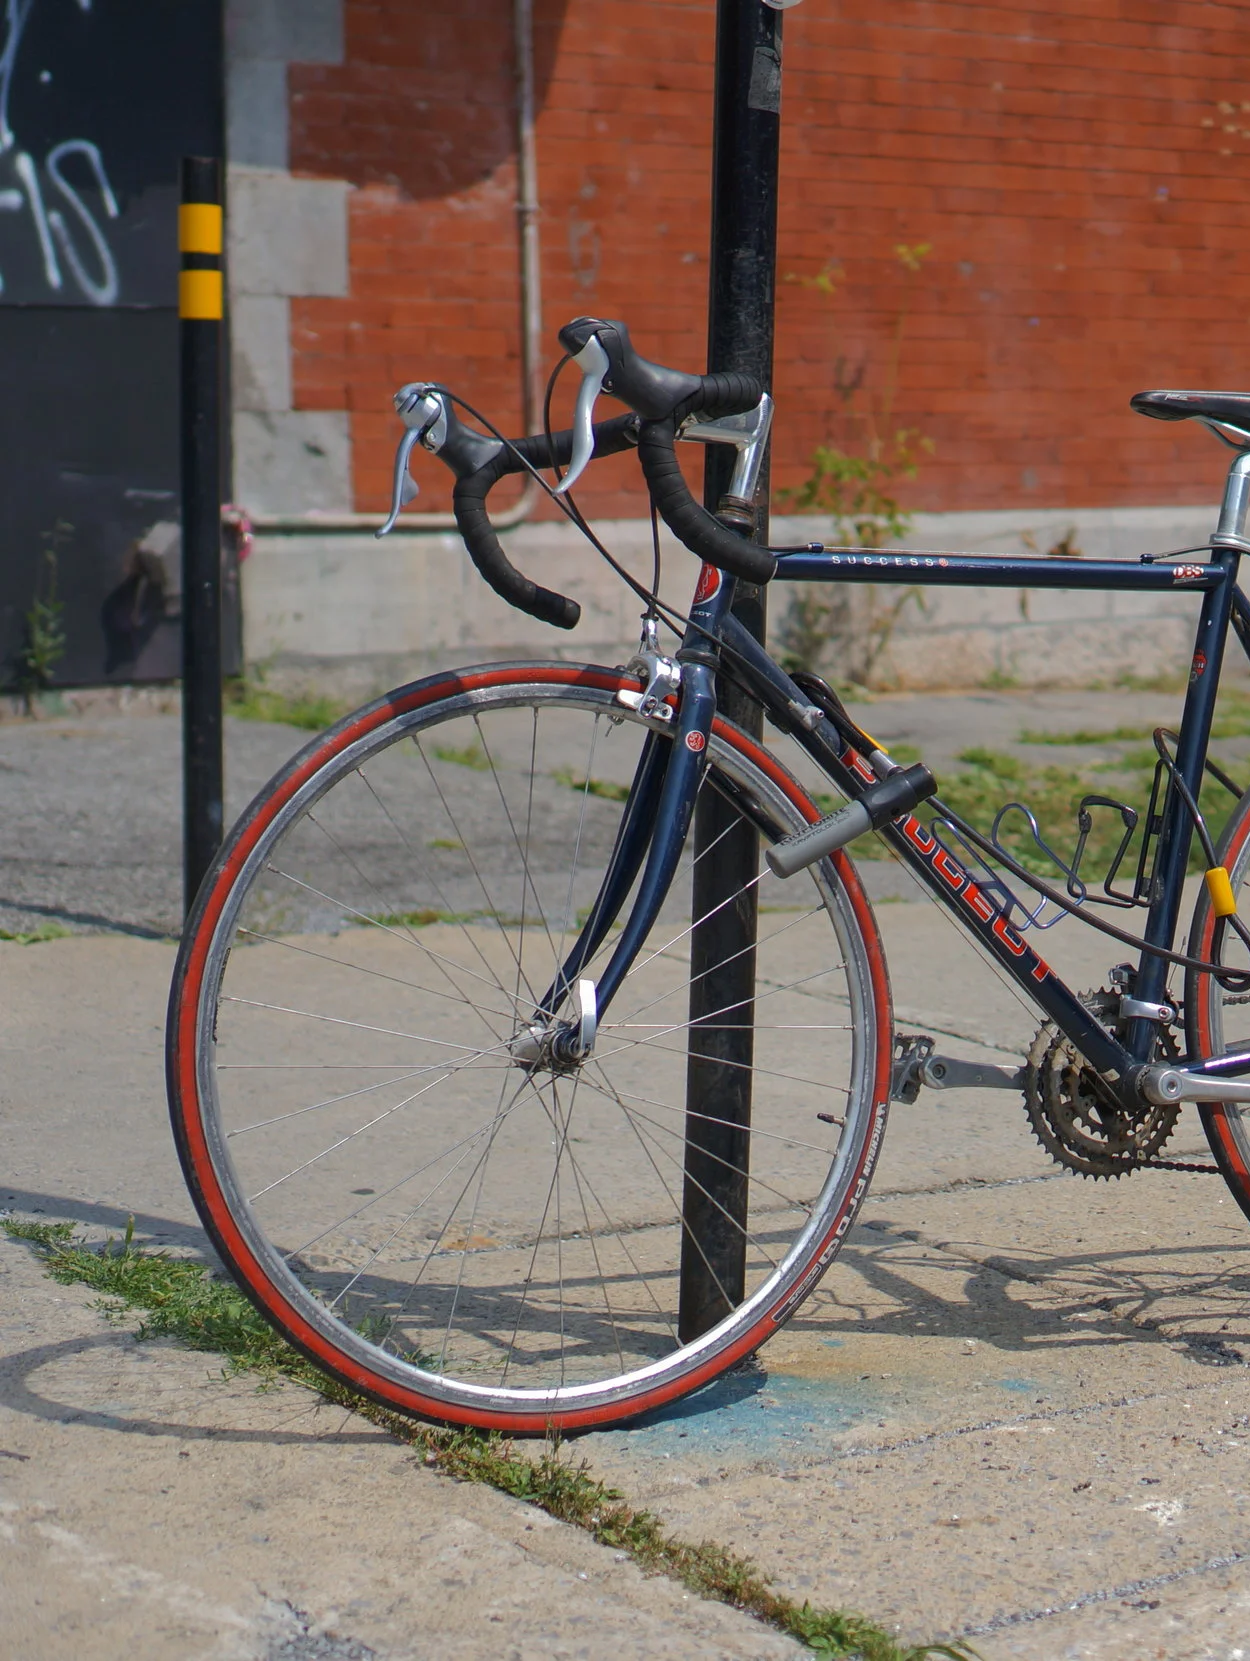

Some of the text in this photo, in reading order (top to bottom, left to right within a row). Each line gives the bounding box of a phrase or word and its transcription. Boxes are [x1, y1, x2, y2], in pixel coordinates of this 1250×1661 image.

[832, 555, 934, 567] SUCCESS
[842, 747, 1059, 984] PUGEOT
[862, 1115, 884, 1177] MICHELIN
